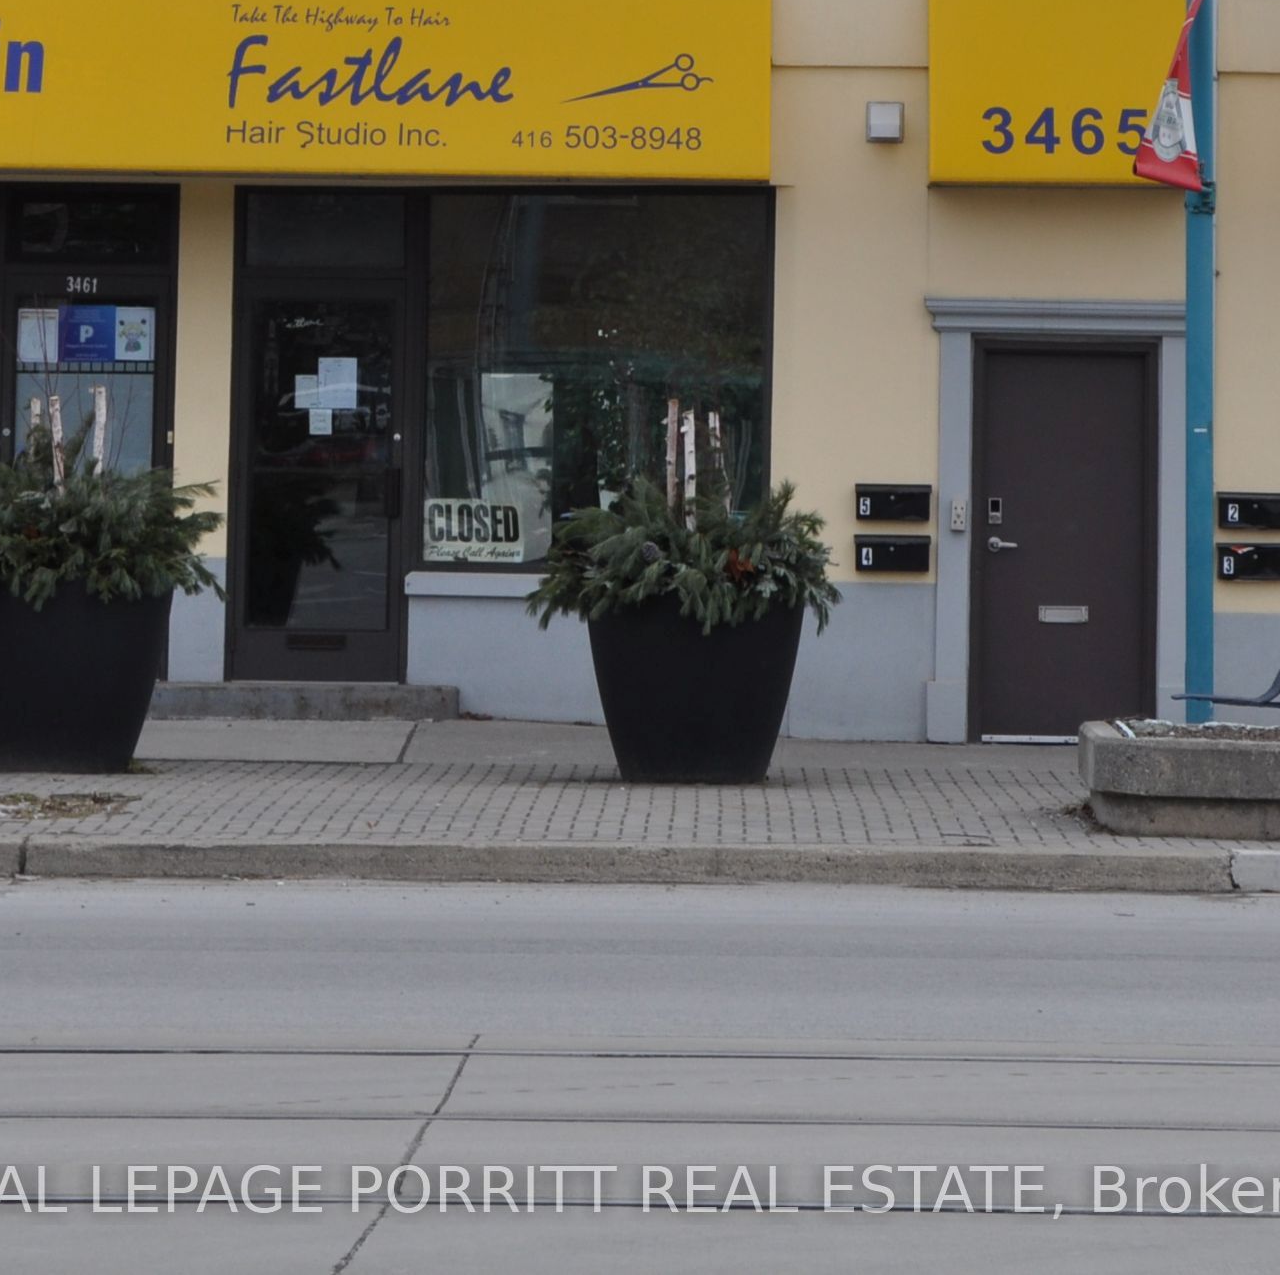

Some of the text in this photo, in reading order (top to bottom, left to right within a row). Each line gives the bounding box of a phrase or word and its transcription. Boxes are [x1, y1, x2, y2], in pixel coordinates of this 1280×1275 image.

[232, 4, 451, 32] Take The Highway To Hair
[227, 34, 514, 109] Fastlane
[226, 120, 447, 149] Hair Studio Inc.
[511, 125, 703, 152] 416 503-8948
[981, 107, 1147, 155] 3465
[66, 276, 97, 293] 3461
[862, 499, 868, 513] 5
[1230, 506, 1237, 521] 2
[428, 503, 520, 542] CLOSED
[429, 545, 515, 560] Please Call Again
[864, 549, 870, 565] 4
[1225, 558, 1232, 573] 3
